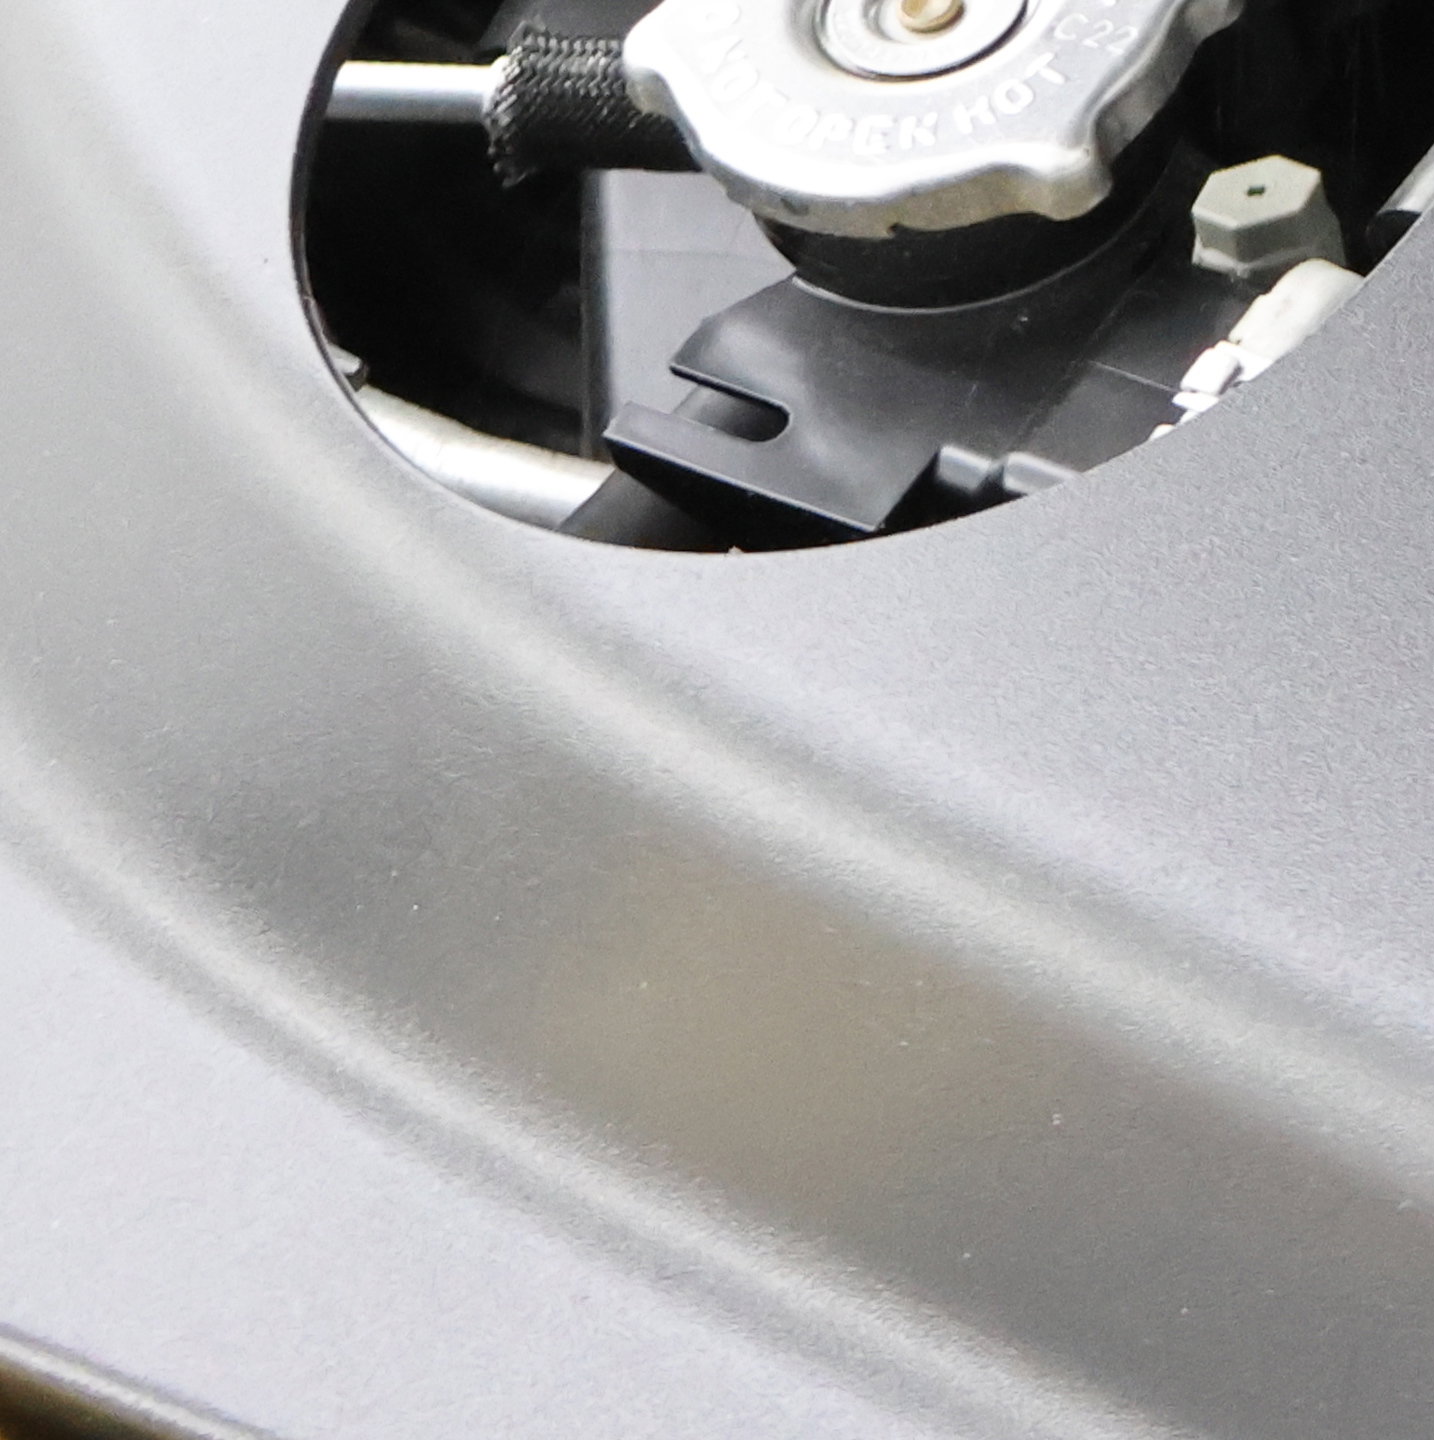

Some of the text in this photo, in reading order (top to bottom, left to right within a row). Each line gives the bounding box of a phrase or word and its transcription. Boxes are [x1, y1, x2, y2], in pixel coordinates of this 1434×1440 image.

[1053, 13, 1138, 57] C22
[772, 110, 937, 154] OPEN
[954, 52, 1070, 134] HOT
